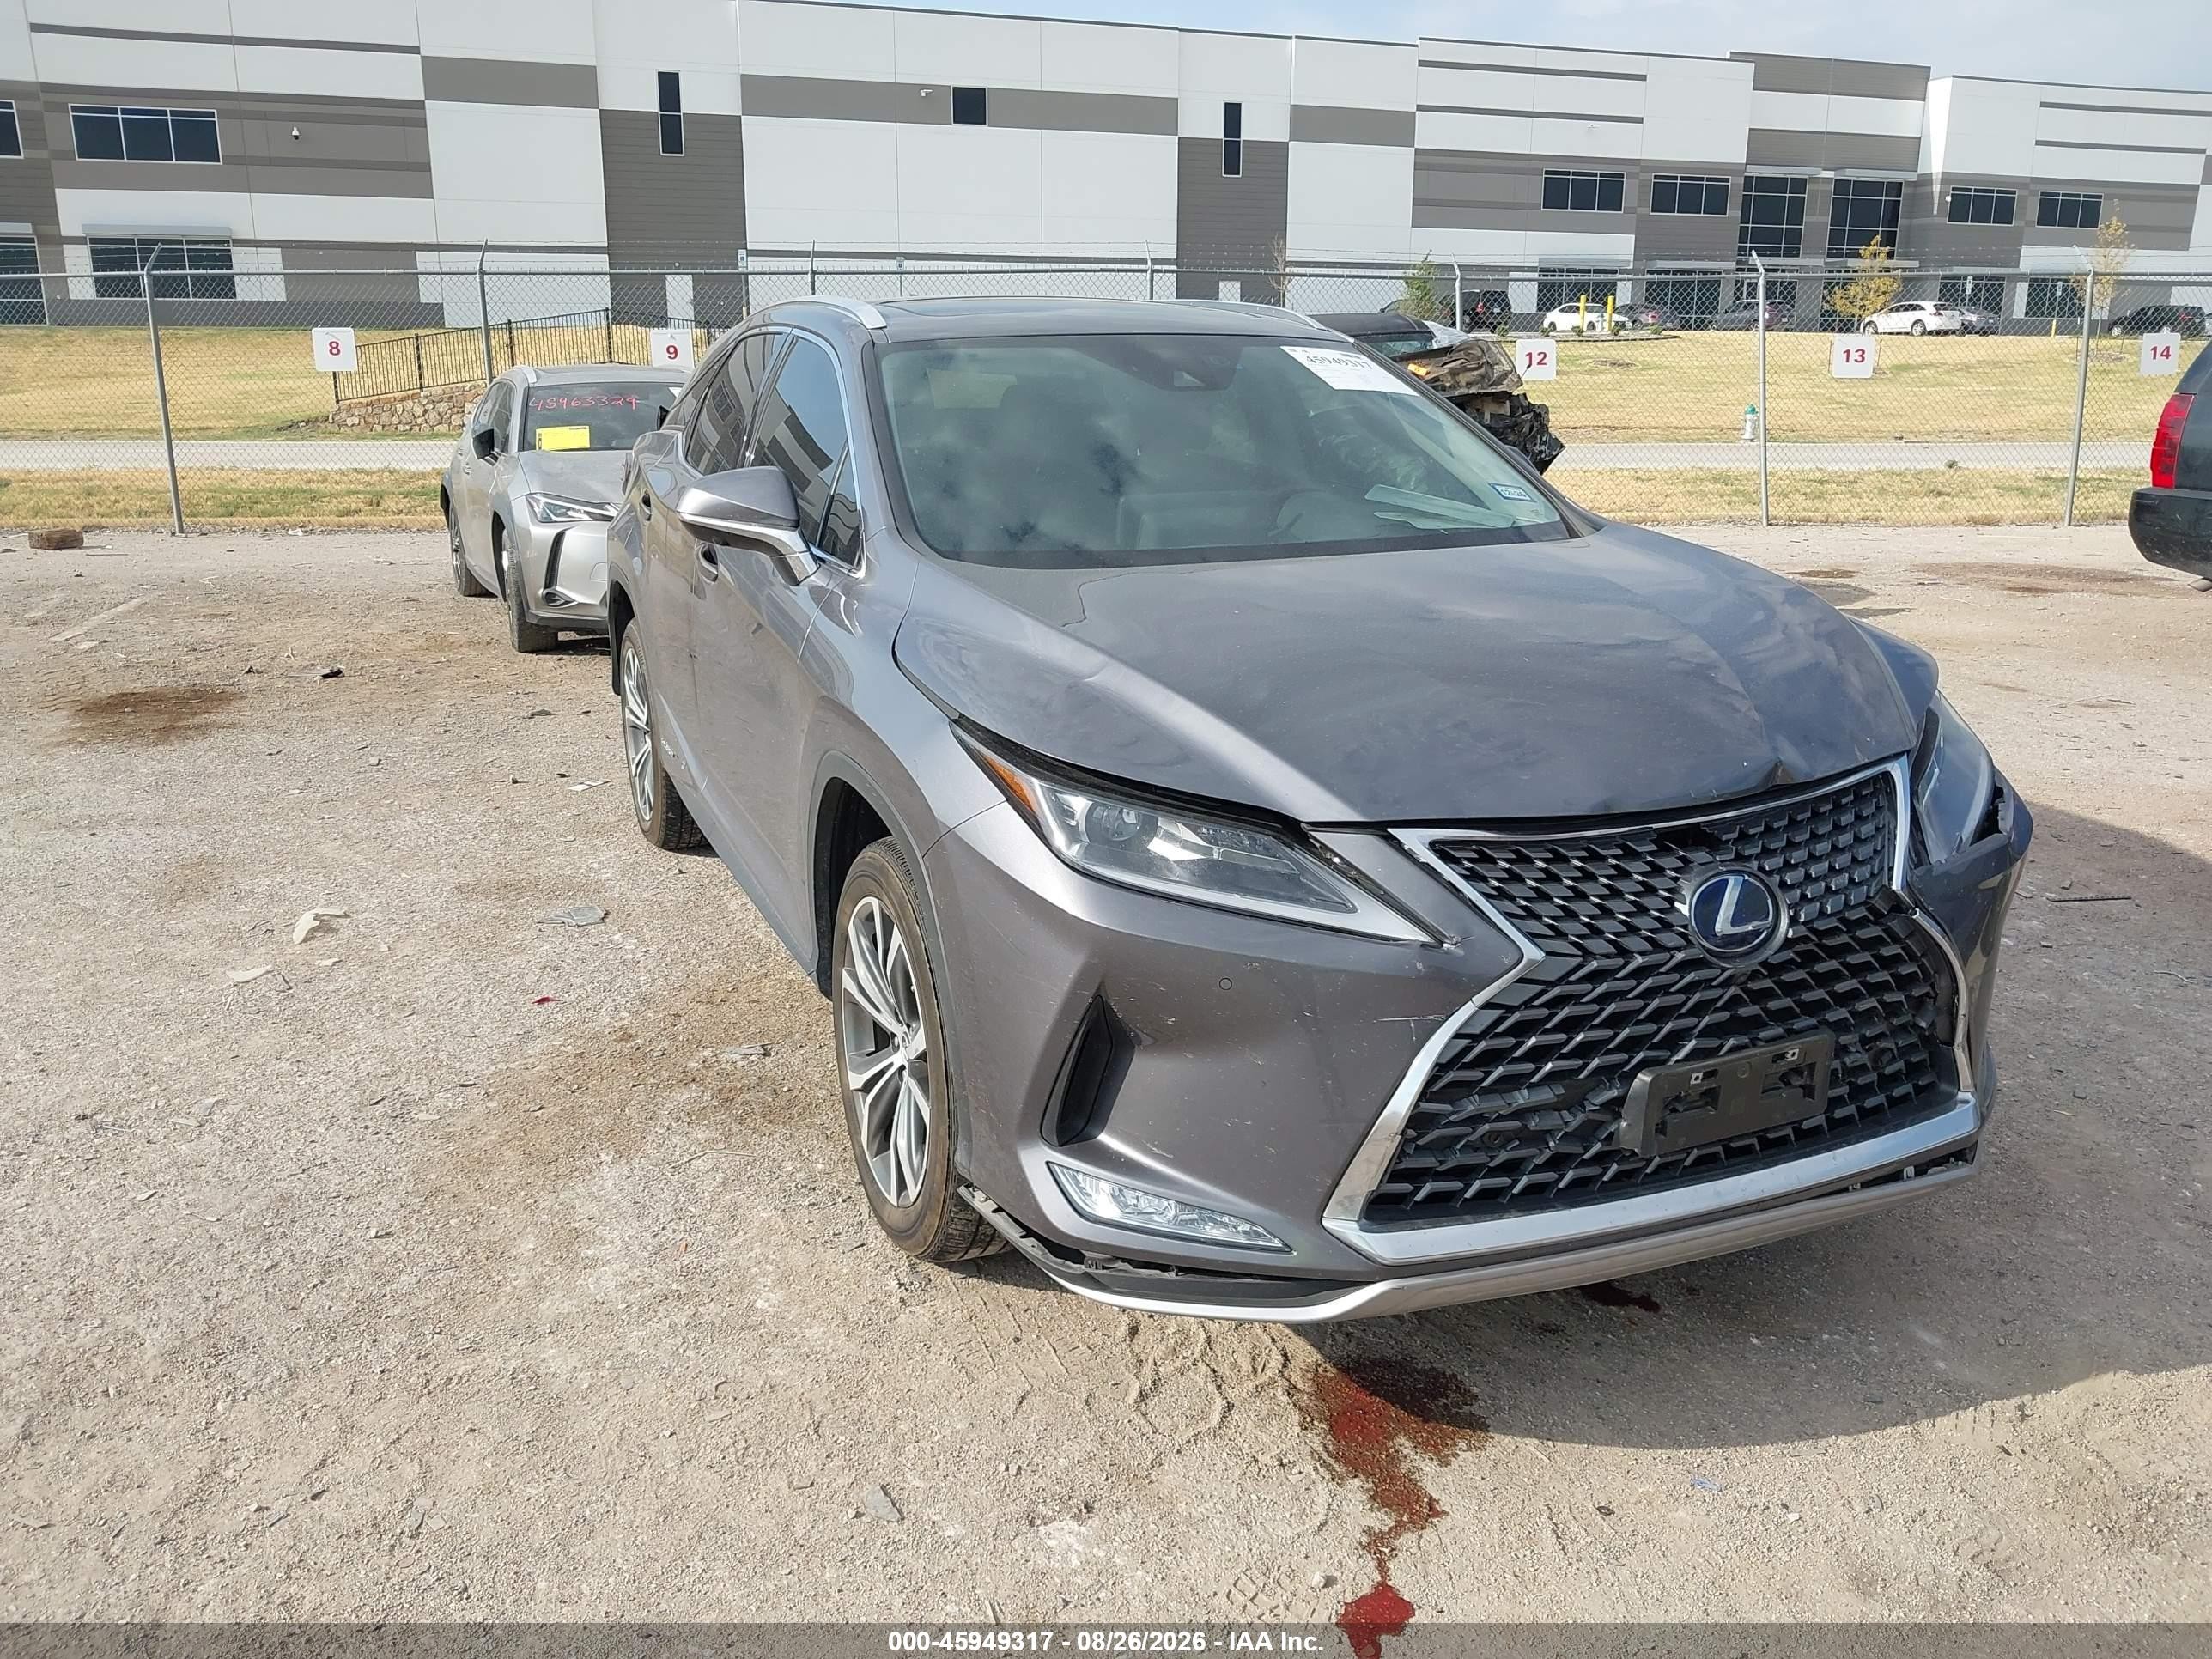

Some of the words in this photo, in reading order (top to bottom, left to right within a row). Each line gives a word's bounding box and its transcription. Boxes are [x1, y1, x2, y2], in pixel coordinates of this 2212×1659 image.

[329, 341, 341, 356] 8
[666, 345, 678, 360] 9
[1843, 349, 1865, 363] 13
[2150, 345, 2172, 360] 14
[1306, 355, 1372, 370] 45949317
[1525, 351, 1547, 366] 12
